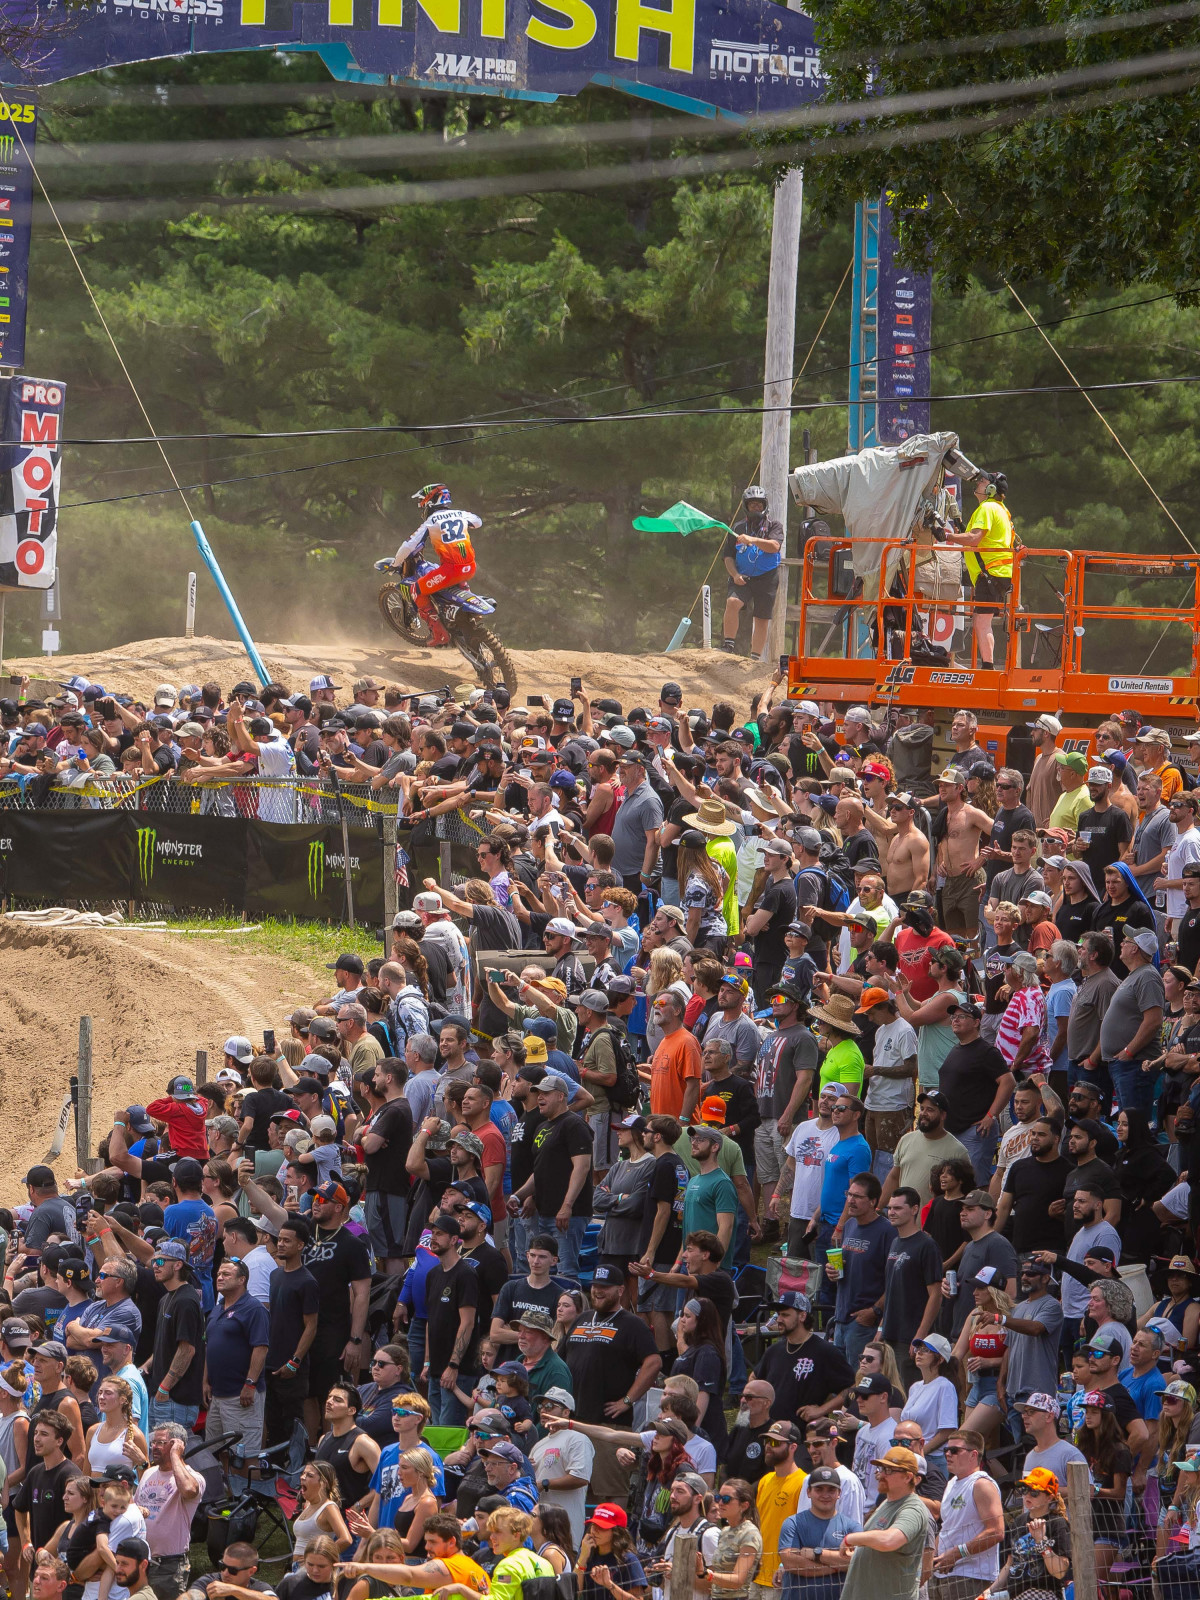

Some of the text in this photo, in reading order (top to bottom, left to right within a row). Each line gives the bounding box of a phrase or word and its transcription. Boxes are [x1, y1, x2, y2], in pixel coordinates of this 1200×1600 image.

[425, 53, 482, 79] AMA
[485, 58, 516, 73] PRO
[485, 73, 516, 82] RACING
[22, 383, 62, 406] PRO
[15, 410, 60, 575] MOTO
[441, 519, 468, 544] 32
[885, 667, 916, 684] JLG
[929, 671, 974, 685] RT3394
[1120, 681, 1170, 691] United Rentals
[156, 840, 202, 858] MONSTER
[162, 858, 195, 867] ENERGY
[325, 853, 361, 870] MONSER
[512, 1300, 551, 1315] LAWRENCE
